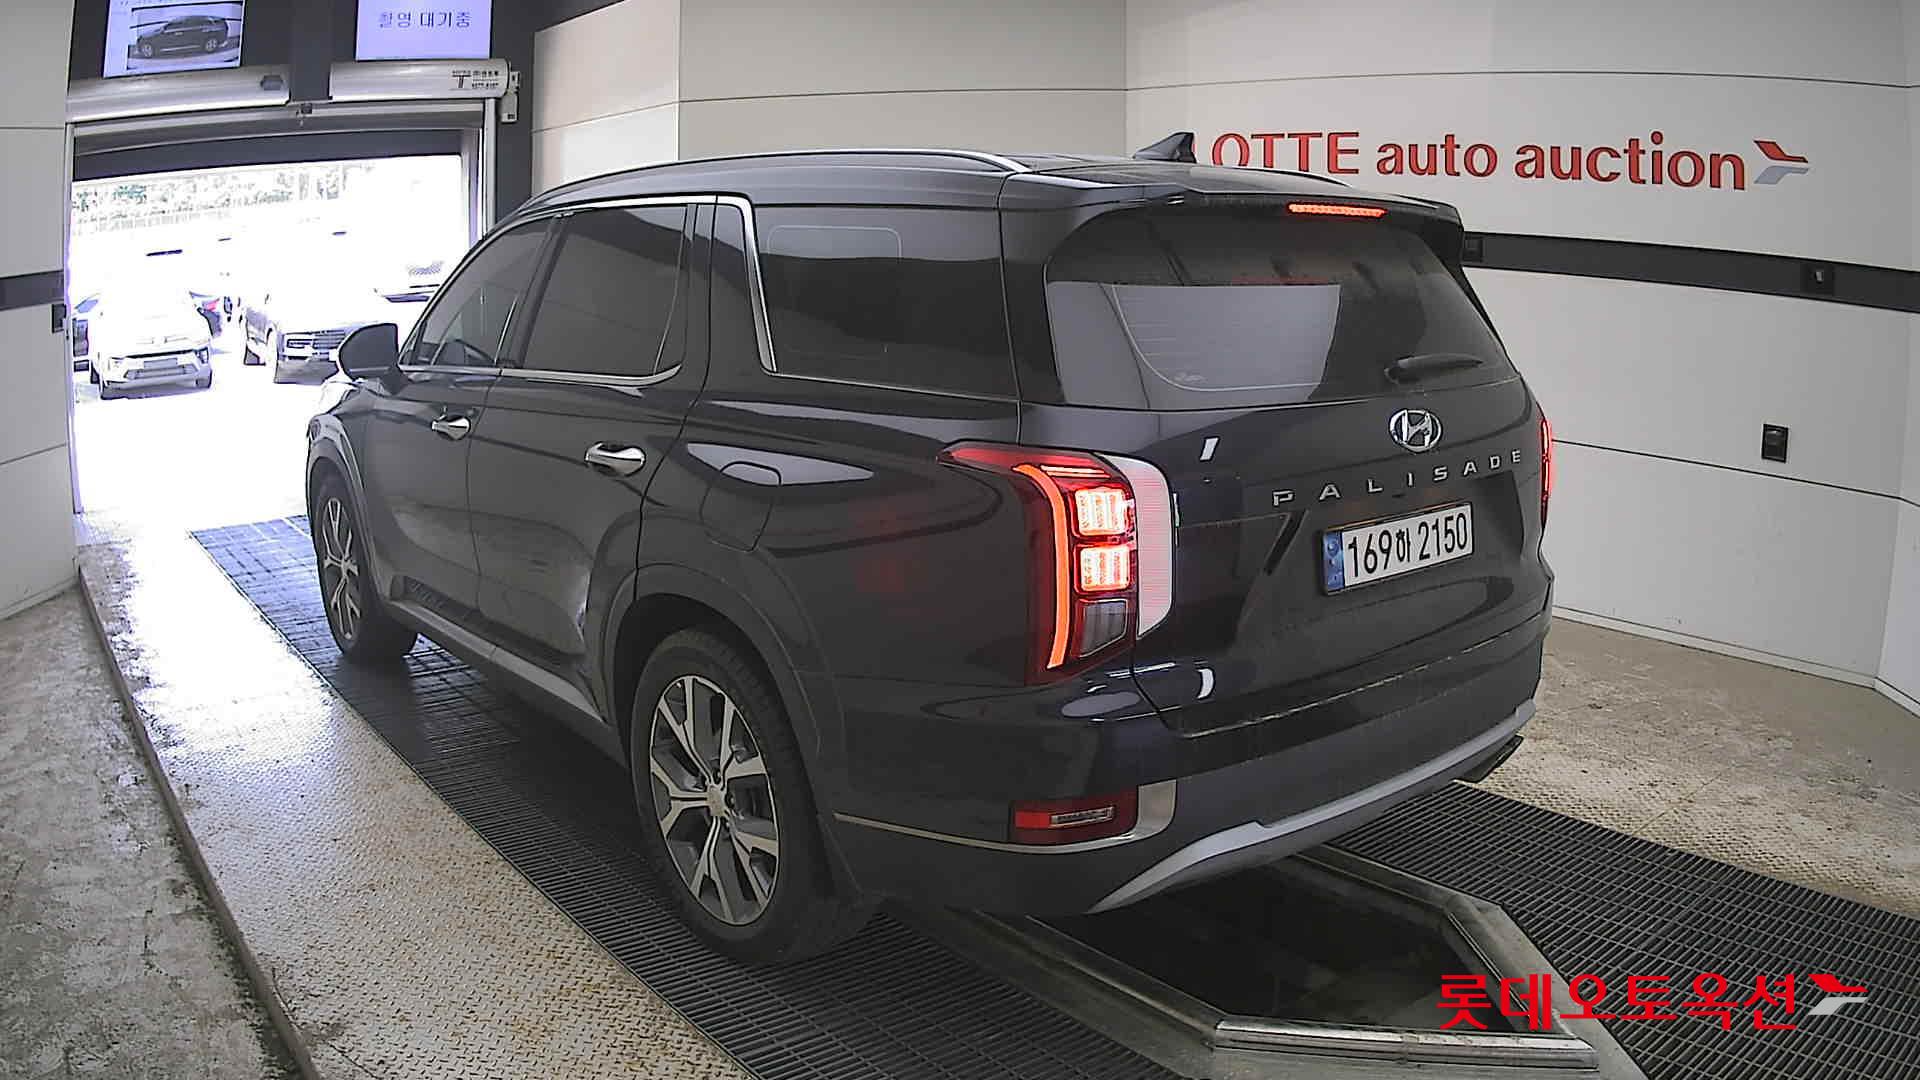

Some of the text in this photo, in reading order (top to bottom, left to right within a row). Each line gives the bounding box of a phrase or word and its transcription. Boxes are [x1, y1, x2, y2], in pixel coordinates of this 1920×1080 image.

[420, 12, 471, 28] 대기중
[1192, 131, 1746, 191] OTTE auto auction
[1272, 450, 1521, 506] PALISADE
